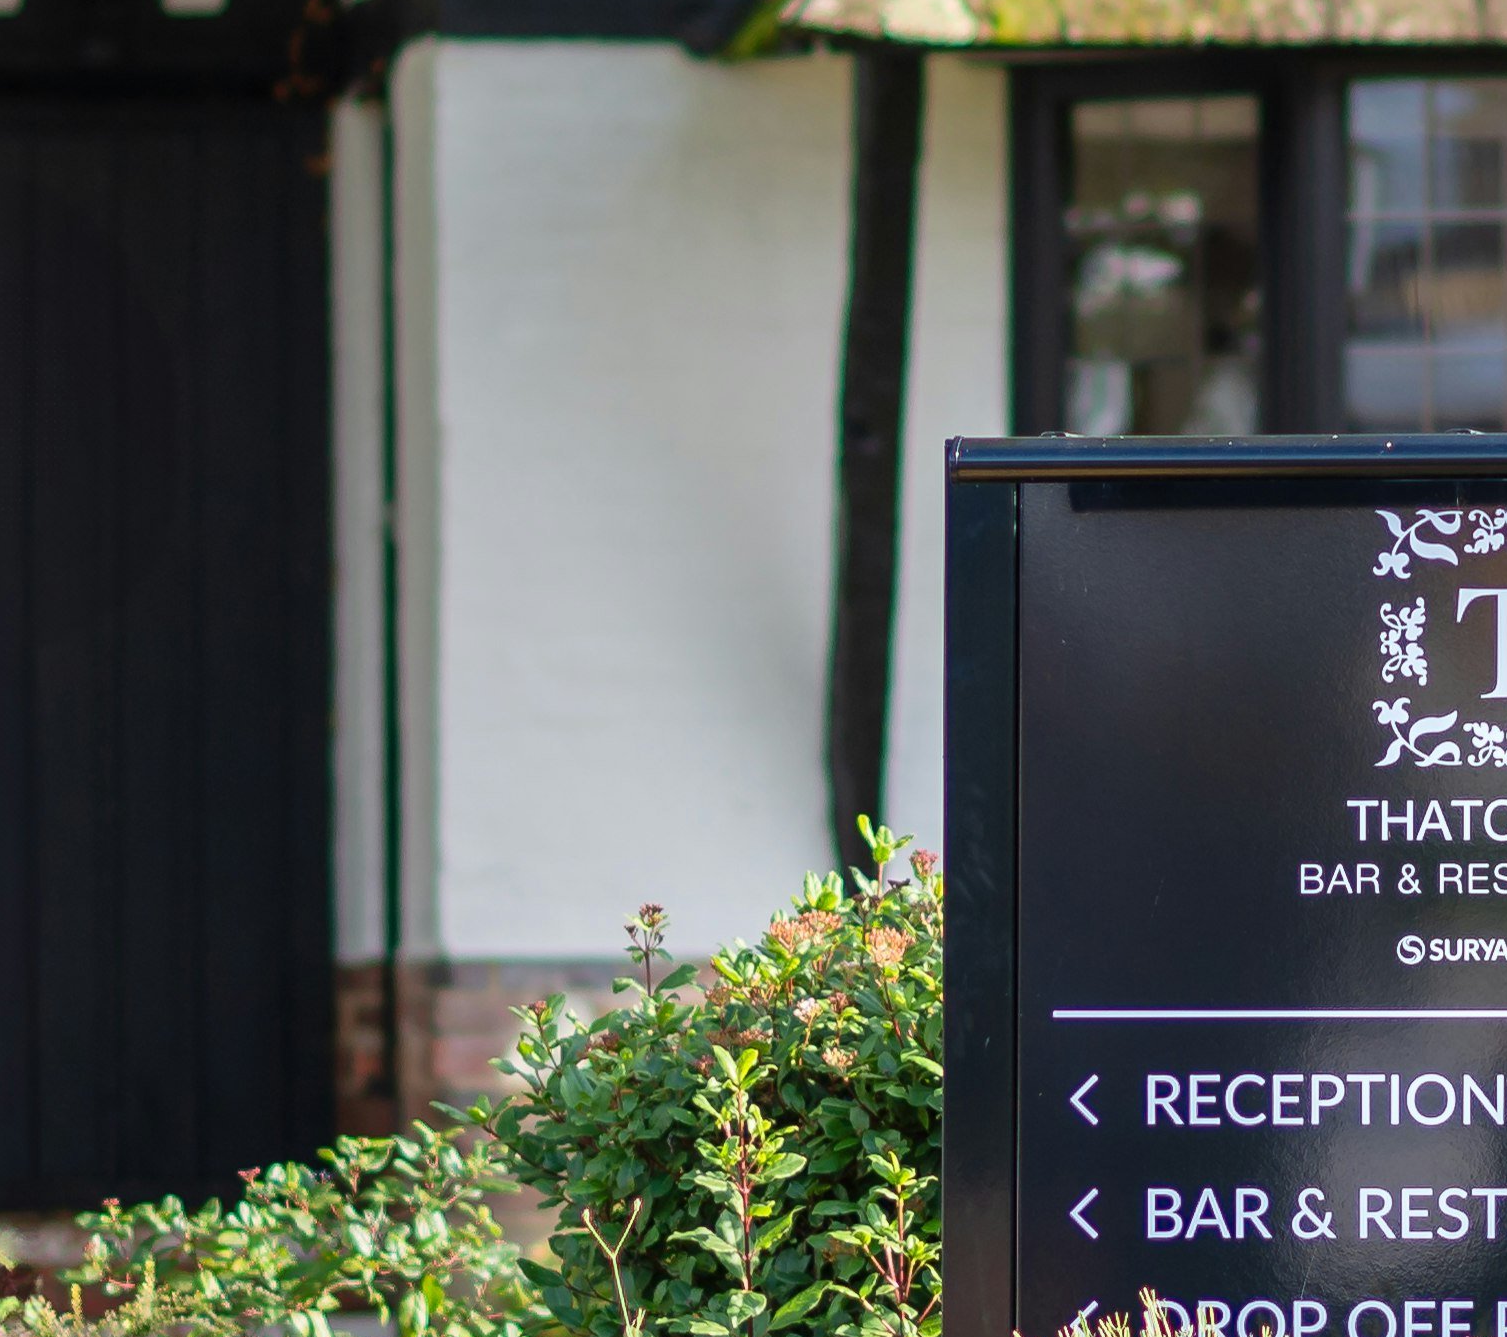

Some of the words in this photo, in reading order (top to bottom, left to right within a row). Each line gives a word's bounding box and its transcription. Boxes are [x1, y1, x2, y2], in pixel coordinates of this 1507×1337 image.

[1300, 863, 1381, 895] BAR
[1397, 863, 1423, 895] &
[1146, 1073, 1505, 1127] RECEPTION
[1147, 1188, 1273, 1241] BAR
[1291, 1188, 1338, 1242] &
